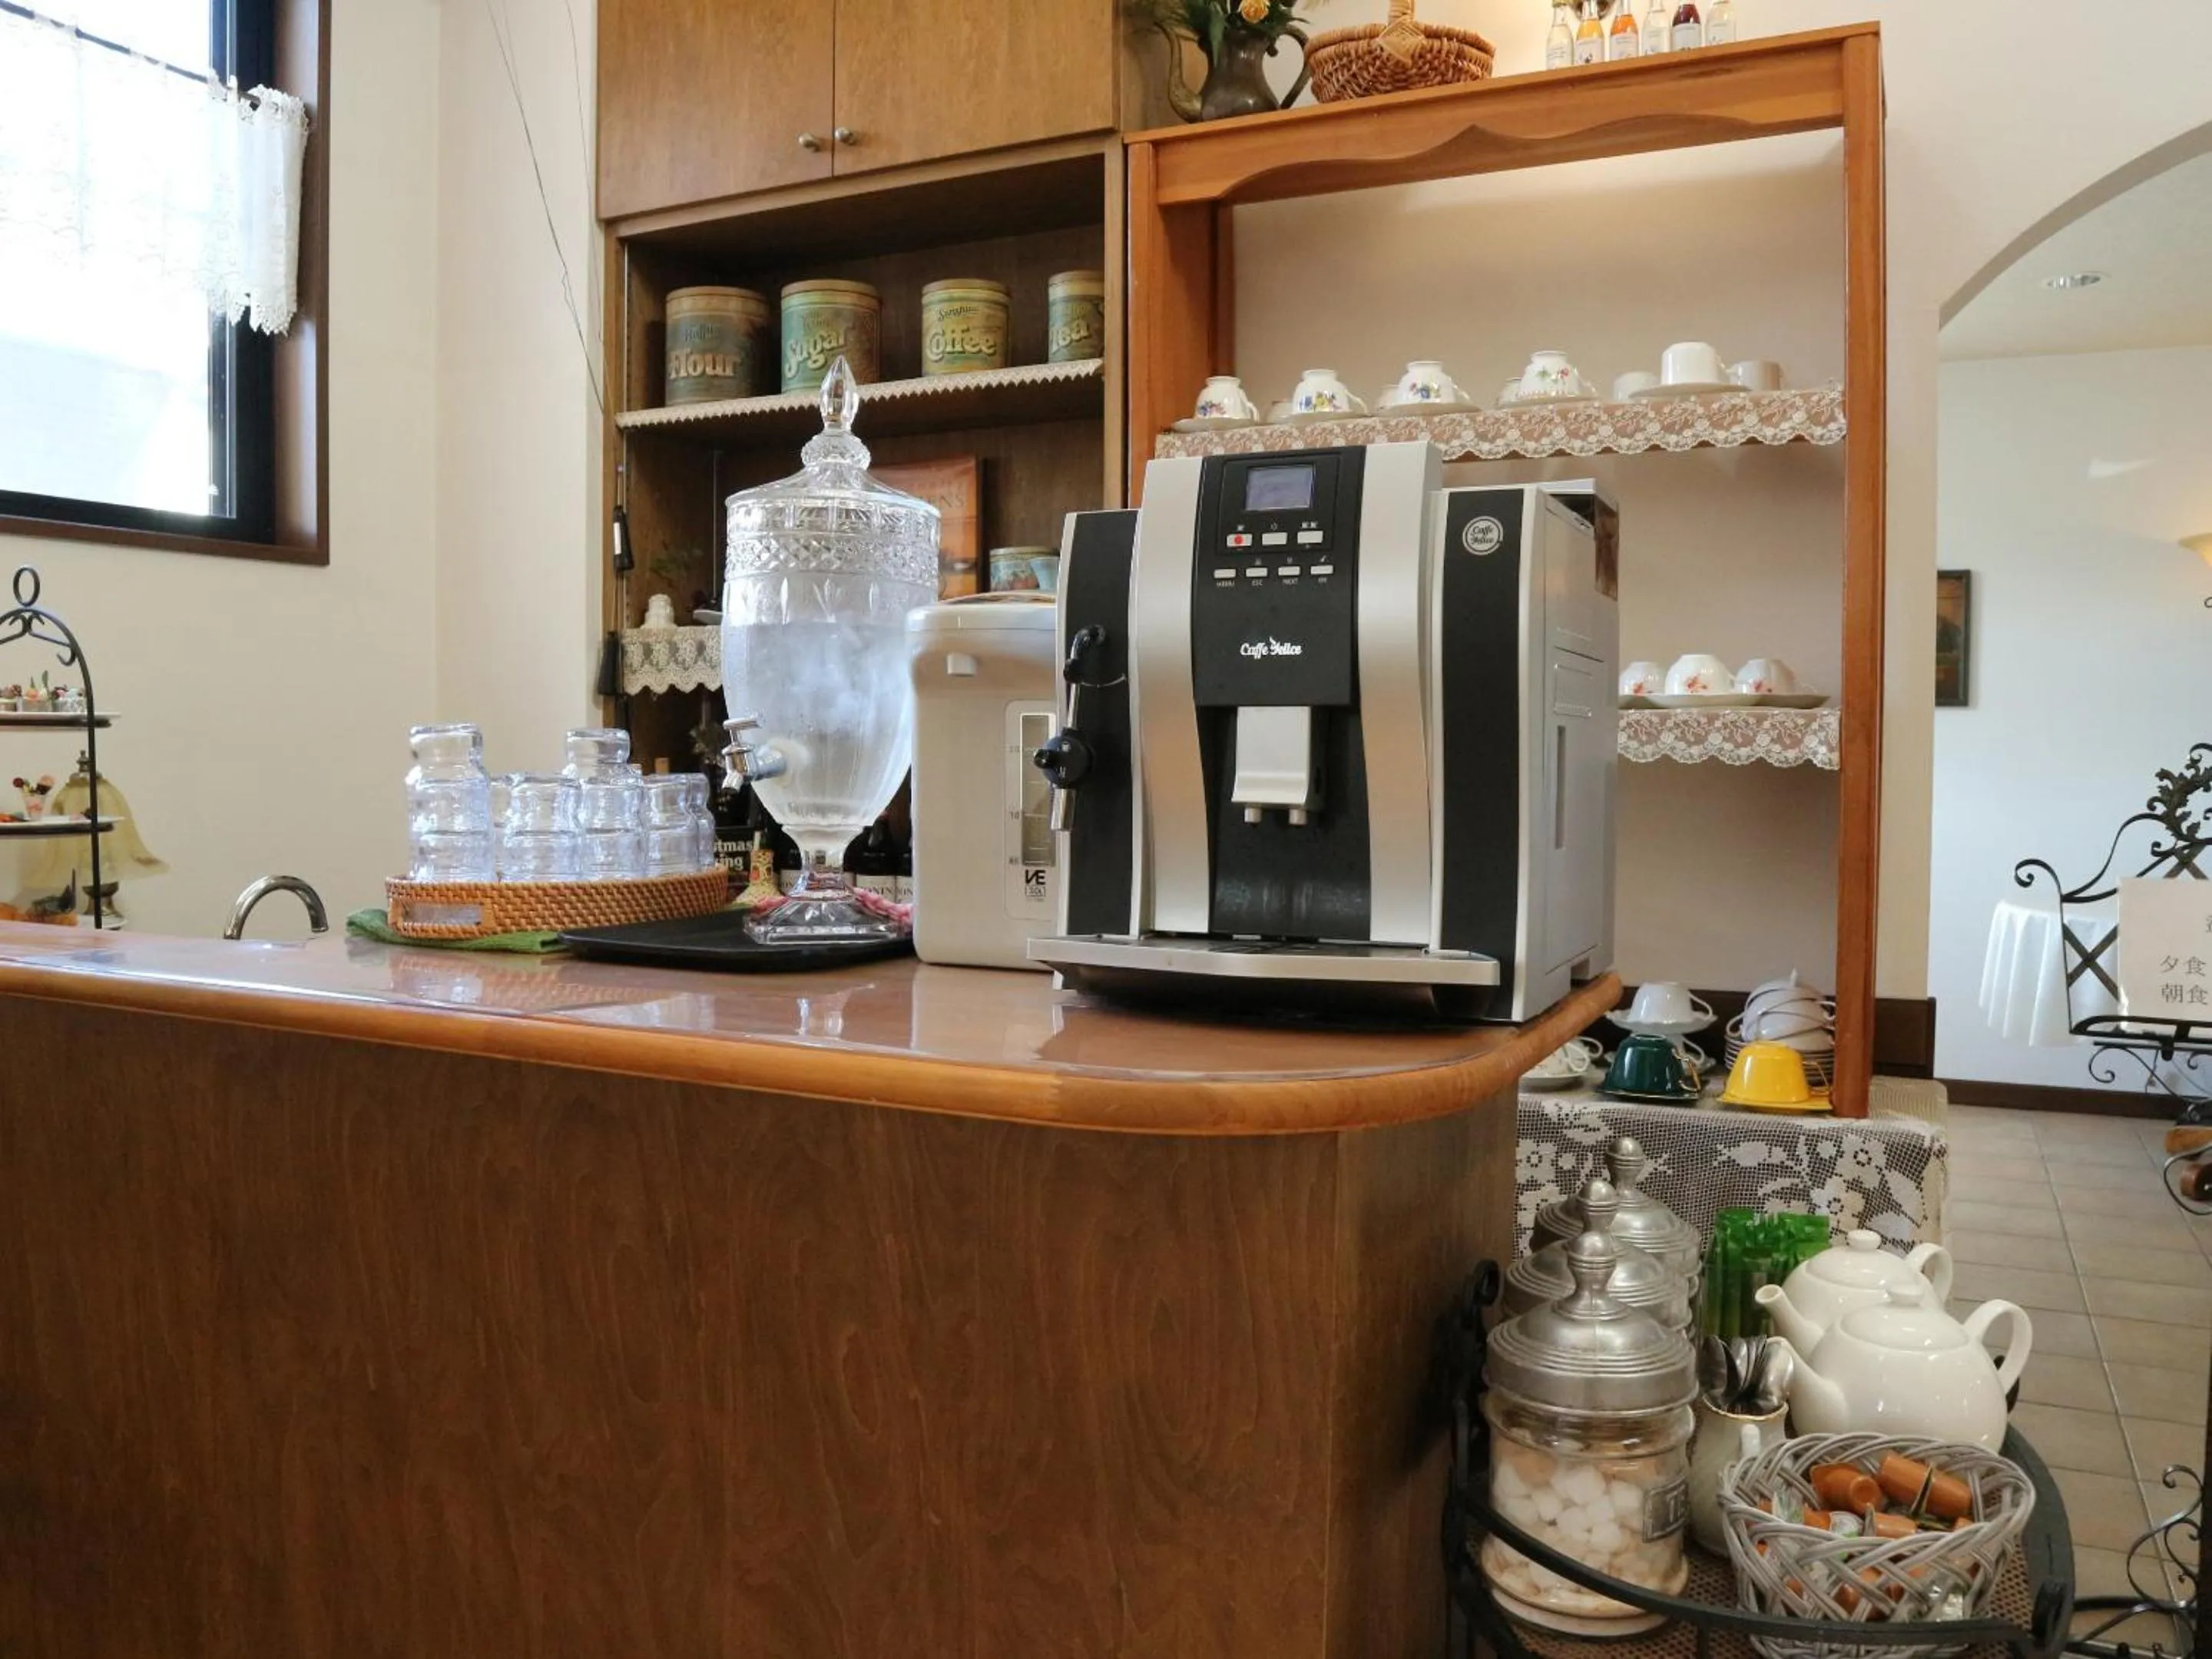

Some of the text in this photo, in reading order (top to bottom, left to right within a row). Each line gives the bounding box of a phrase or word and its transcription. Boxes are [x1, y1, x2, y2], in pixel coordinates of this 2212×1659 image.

[926, 323, 998, 362] Coffee
[2160, 955, 2207, 977] 夕食
[2161, 982, 2209, 1005] 朝食
